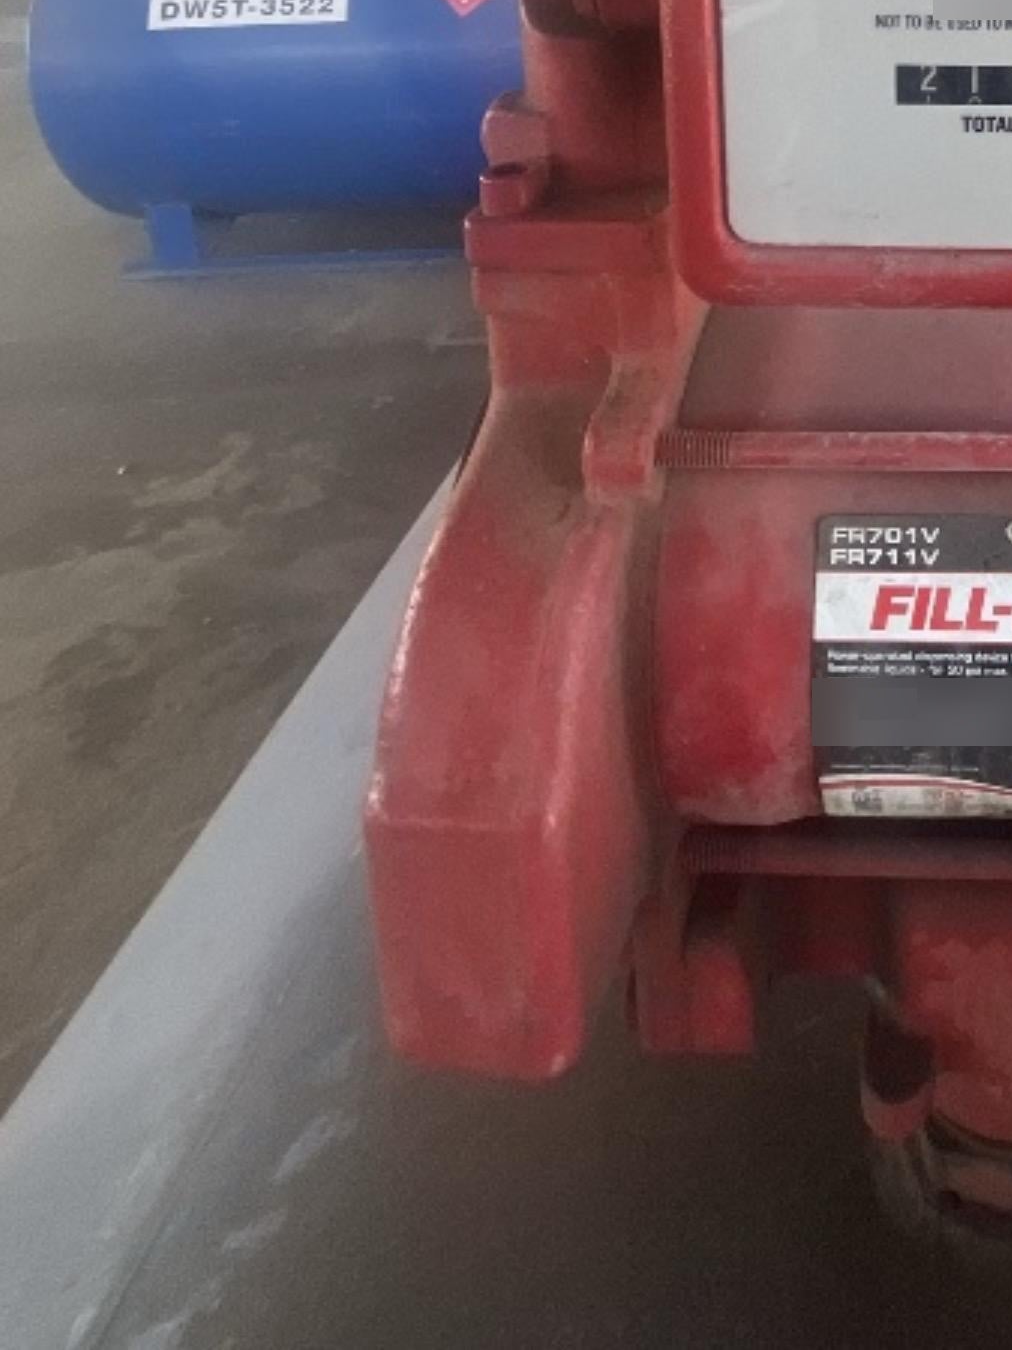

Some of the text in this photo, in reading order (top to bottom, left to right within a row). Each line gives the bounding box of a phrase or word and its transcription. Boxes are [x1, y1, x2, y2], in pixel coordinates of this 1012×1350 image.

[905, 14, 921, 29] TO
[831, 527, 940, 544] FR701V
[830, 548, 940, 565] FR711V
